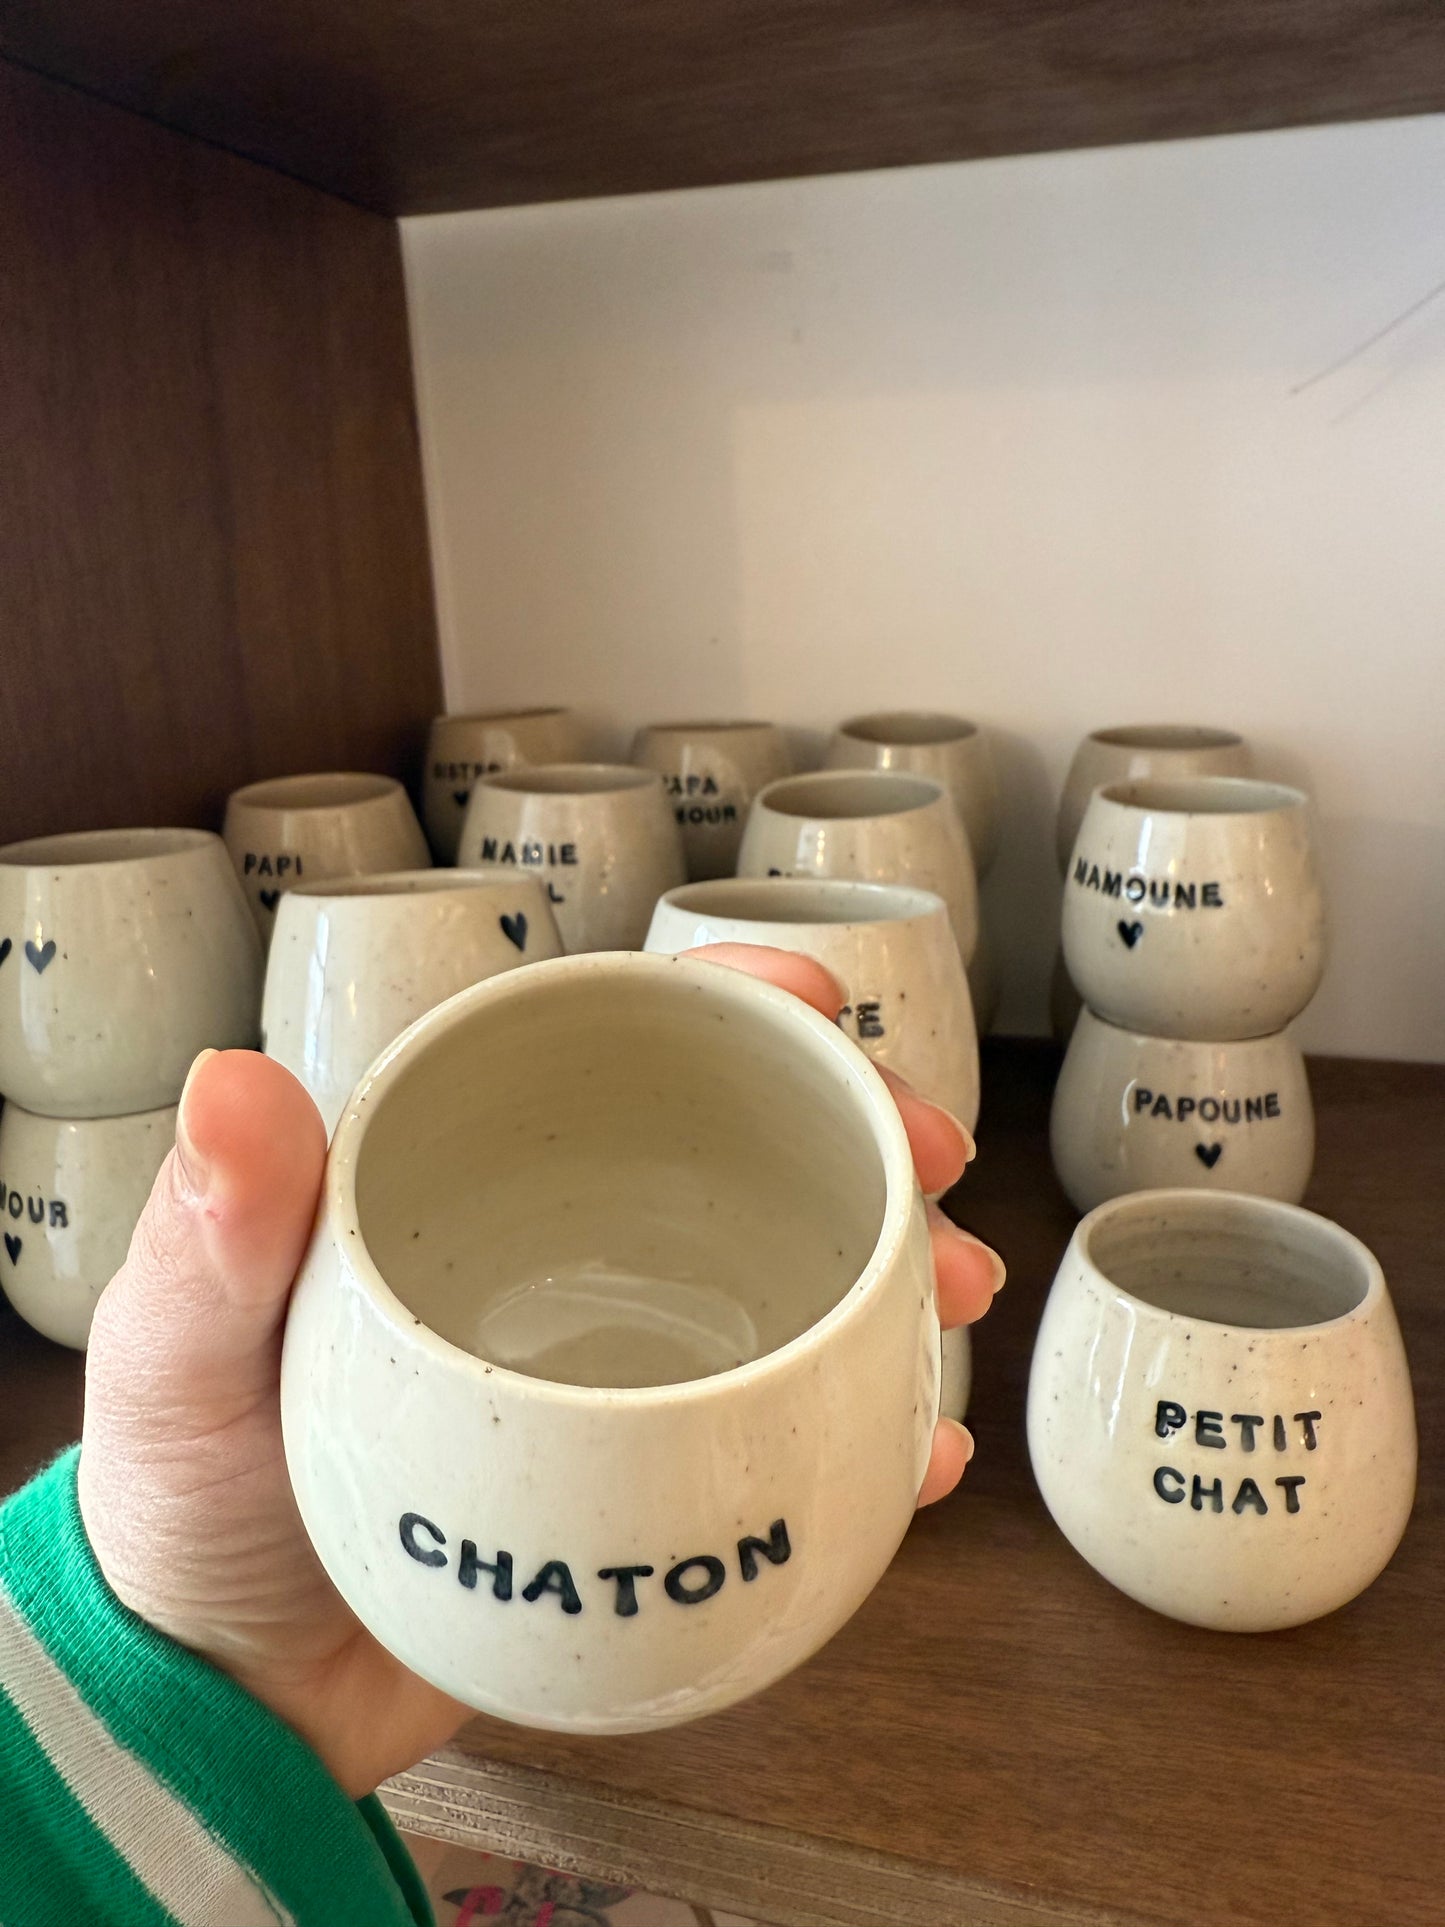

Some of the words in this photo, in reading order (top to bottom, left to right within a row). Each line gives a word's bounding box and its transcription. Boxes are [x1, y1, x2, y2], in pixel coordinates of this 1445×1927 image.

[244, 852, 302, 877] PAPI
[1074, 857, 1223, 908] MAMOUNE
[1134, 1088, 1281, 1123] PAPOUNE
[1155, 1400, 1322, 1452] PETIT
[1153, 1466, 1306, 1515] CHAT
[399, 1512, 792, 1617] CHATON
